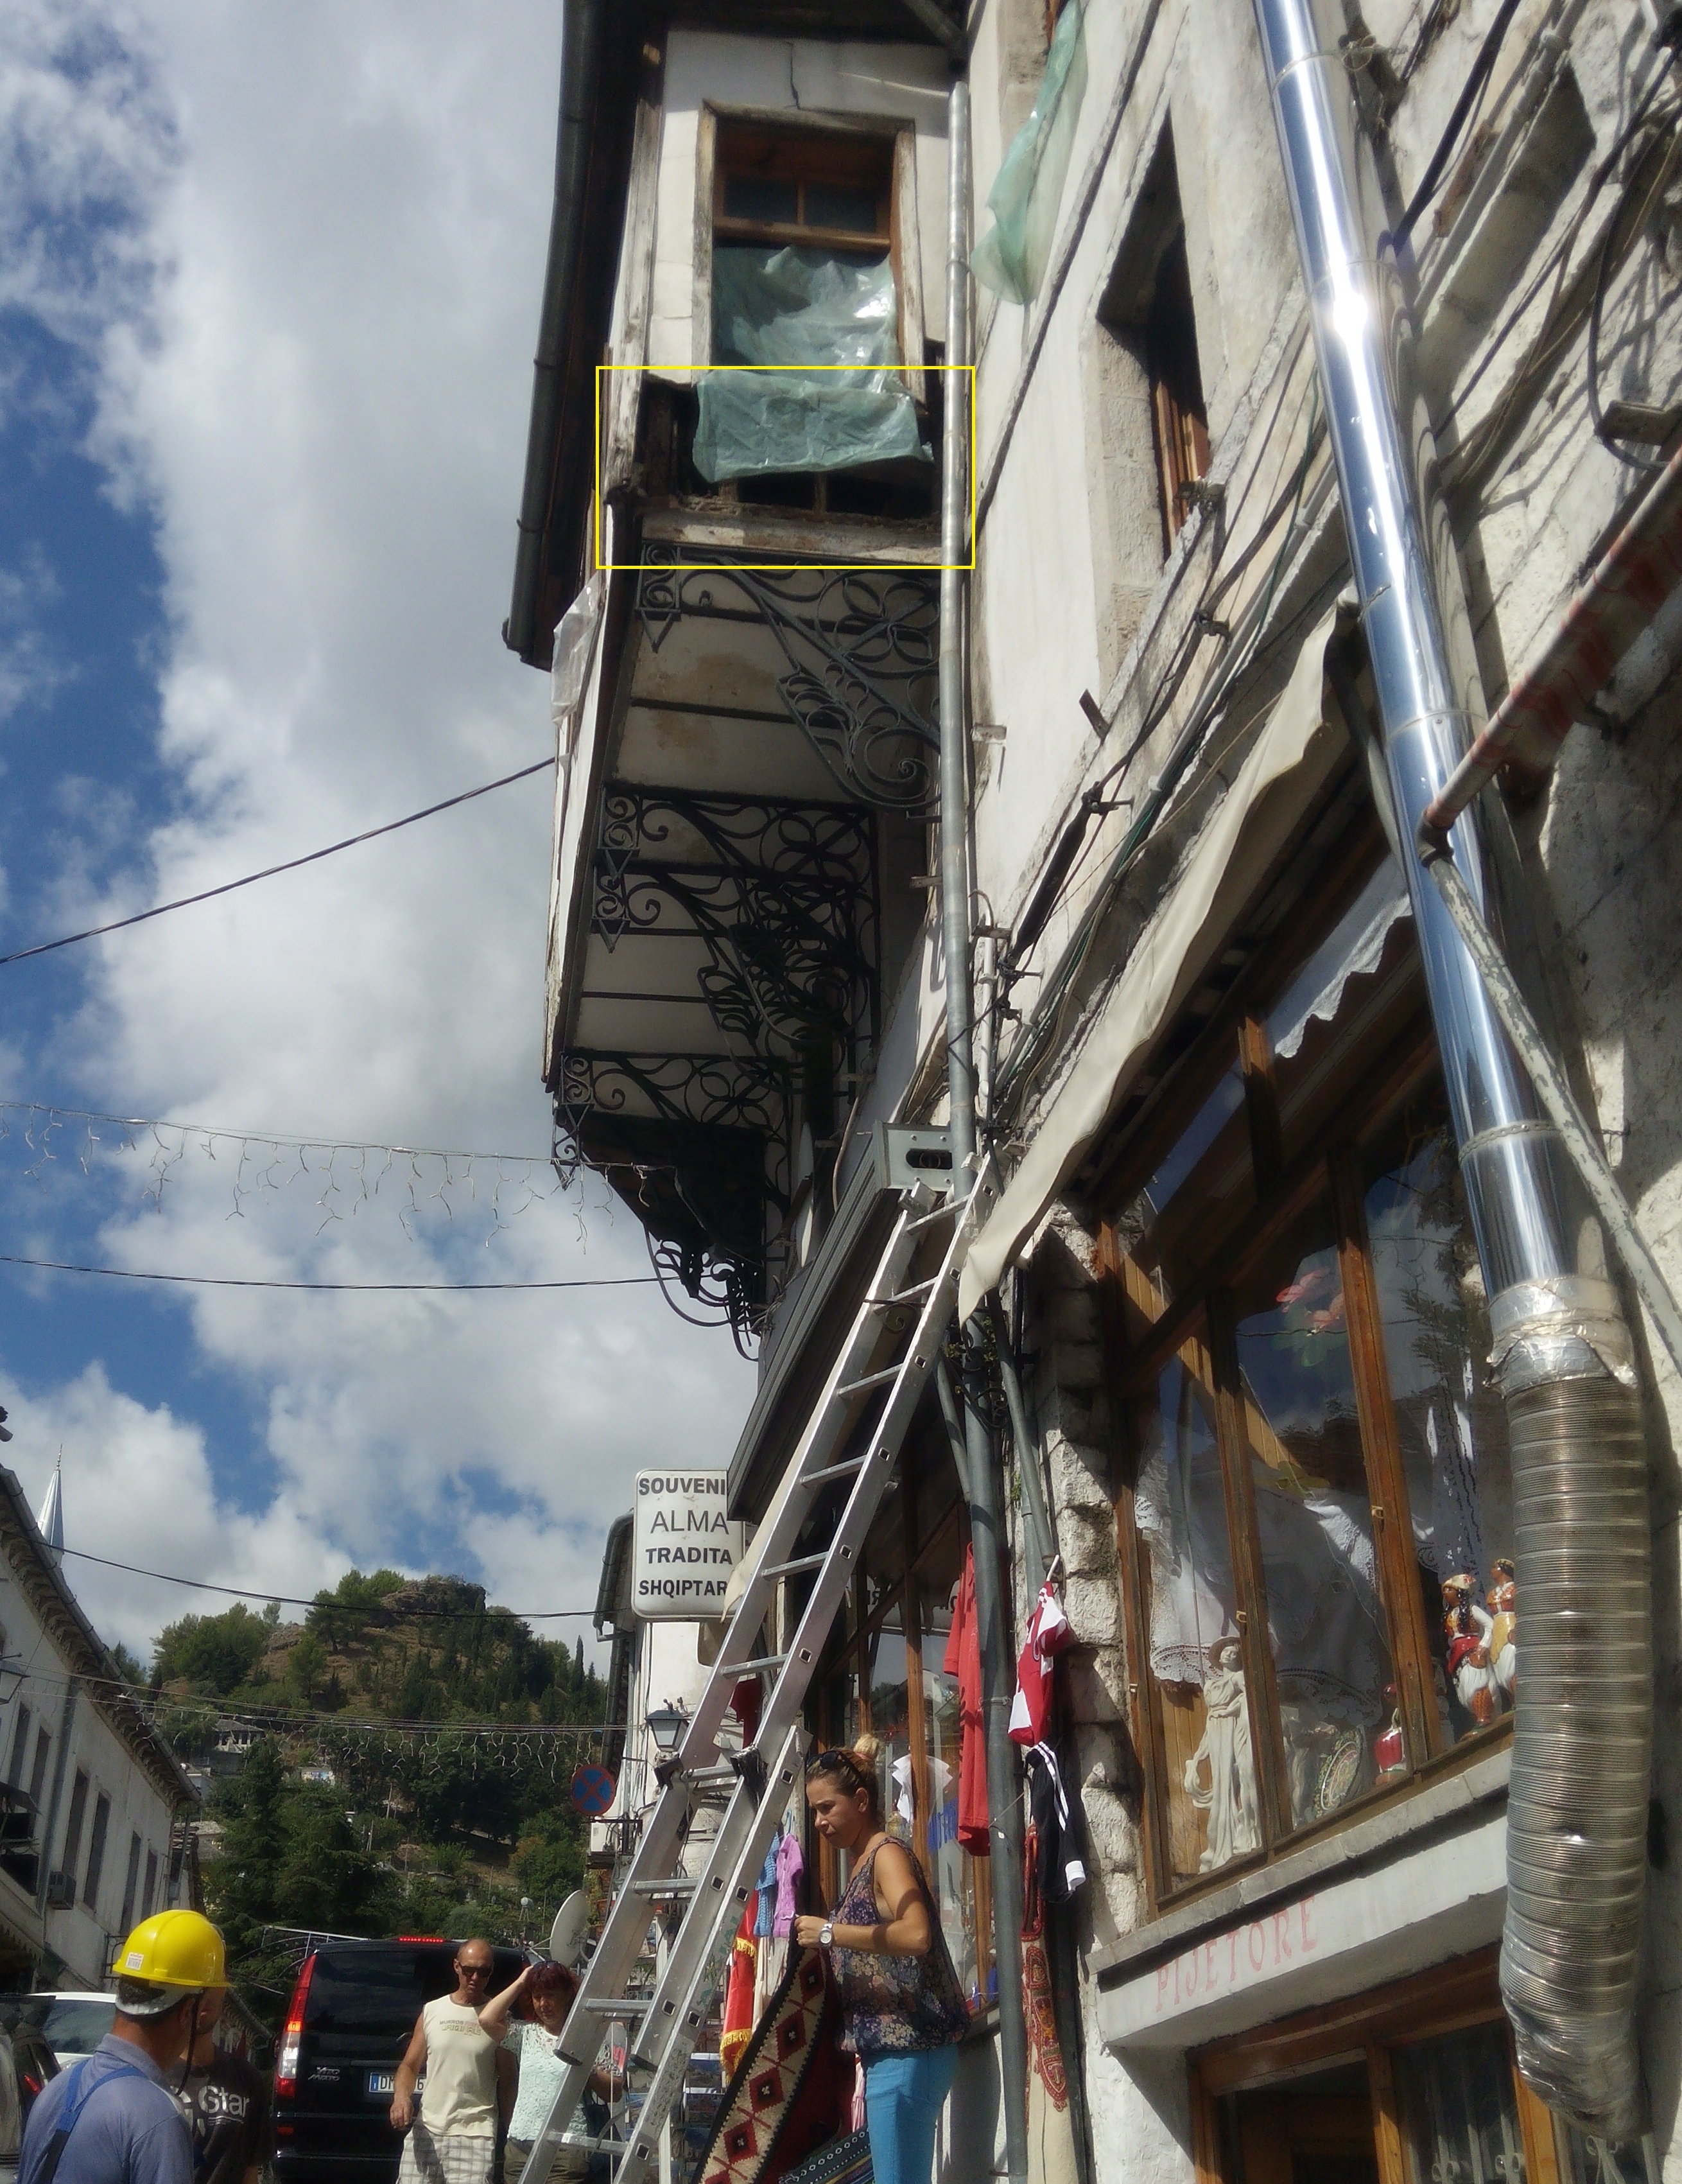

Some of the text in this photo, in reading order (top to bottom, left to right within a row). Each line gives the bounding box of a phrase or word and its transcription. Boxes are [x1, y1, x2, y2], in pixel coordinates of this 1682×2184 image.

[650, 1510, 729, 1535] ALMA
[645, 1547, 733, 1565] TRADITA
[1156, 1896, 1317, 2013] PIJETORE
